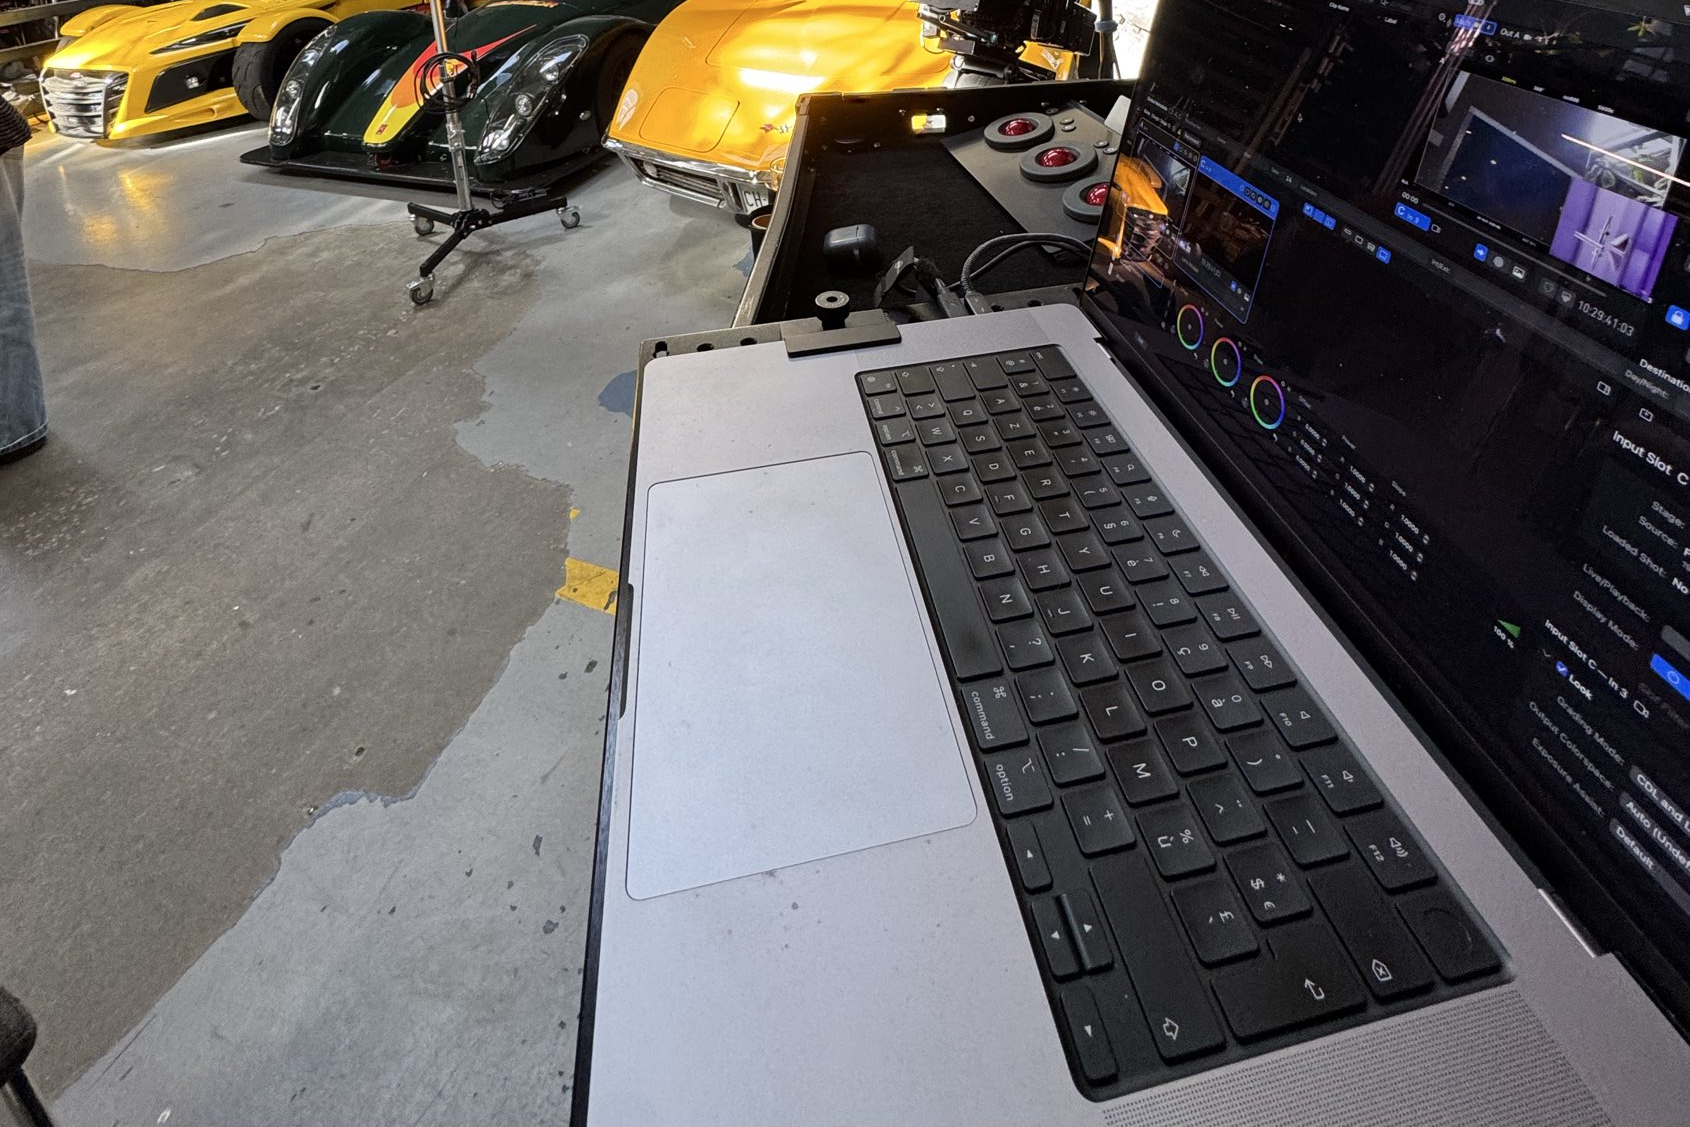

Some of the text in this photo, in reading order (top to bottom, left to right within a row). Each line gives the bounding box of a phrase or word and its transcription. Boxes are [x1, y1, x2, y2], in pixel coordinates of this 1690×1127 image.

[1501, 28, 1513, 37] Out
[1401, 192, 1418, 205] 00:00
[1398, 206, 1405, 215] C
[1579, 301, 1634, 336] 10:29:41:03
[890, 450, 905, 476] command
[1613, 431, 1689, 485] Input Slot C
[1651, 501, 1685, 530] Stage:
[1401, 515, 1419, 534] 1.0000
[1639, 515, 1679, 548] Source:
[1396, 532, 1413, 552] 1.0000
[1390, 550, 1407, 570] 1.0000
[1603, 525, 1689, 594] Loaded Shot: No
[1038, 565, 1050, 573] H
[1000, 594, 1012, 603] N
[1100, 586, 1113, 595] U
[1583, 562, 1651, 623] Live/Playback:
[1212, 613, 1220, 621] F8
[1573, 591, 1638, 650] Display Mode:
[1494, 625, 1514, 648] 100 %
[1080, 654, 1094, 663] K
[1244, 661, 1253, 669] F9
[1545, 620, 1628, 698] Input Slot C In 3
[1152, 680, 1166, 690] O
[1569, 674, 1592, 700] Look
[1106, 706, 1118, 716] L
[1212, 699, 1225, 707] à
[972, 690, 996, 739] command
[1280, 713, 1292, 726] F10
[1556, 695, 1624, 765] Grading Mode:
[1182, 737, 1197, 747] P
[1529, 701, 1616, 792] Output Colorspace:
[1532, 737, 1573, 783] Exposure
[1133, 763, 1151, 778] M
[996, 764, 1013, 801] option
[1321, 775, 1334, 788] F11
[1637, 773, 1684, 824] CDL and
[1626, 802, 1651, 829] Auto
[1158, 836, 1173, 847] ù
[1180, 829, 1194, 843] %
[1369, 845, 1384, 861] F12
[1615, 825, 1655, 871] Default
[1251, 878, 1264, 889] $
[1264, 901, 1275, 910] €
[1219, 911, 1234, 922] £
